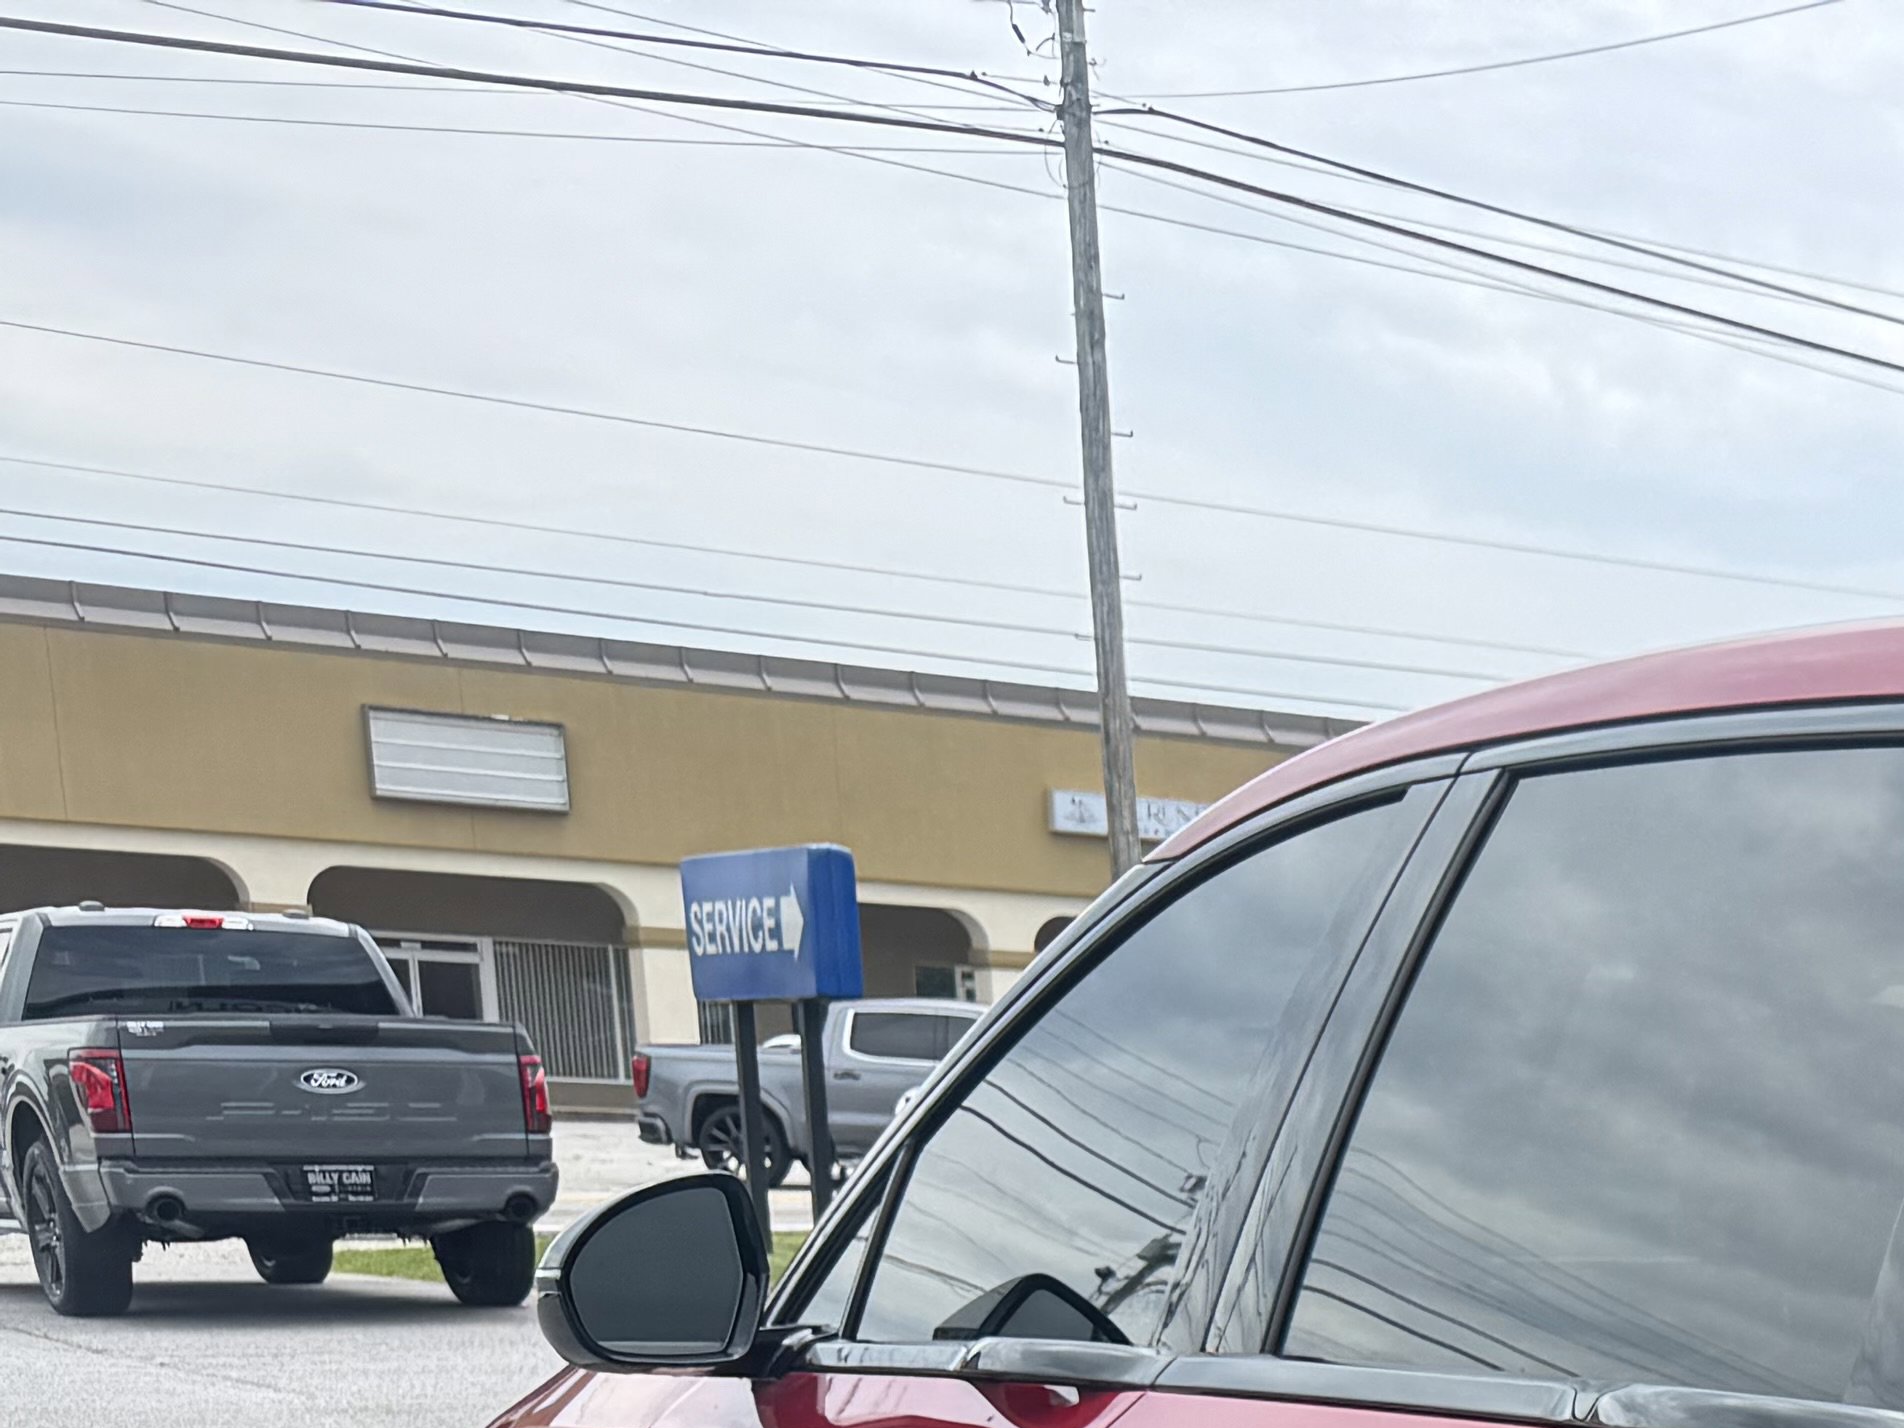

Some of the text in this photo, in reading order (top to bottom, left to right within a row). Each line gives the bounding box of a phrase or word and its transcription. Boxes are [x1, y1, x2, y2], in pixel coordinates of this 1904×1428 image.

[690, 896, 779, 957] SERVICE
[310, 1072, 348, 1088] Ford
[307, 1171, 372, 1185] BILLY CAIN
